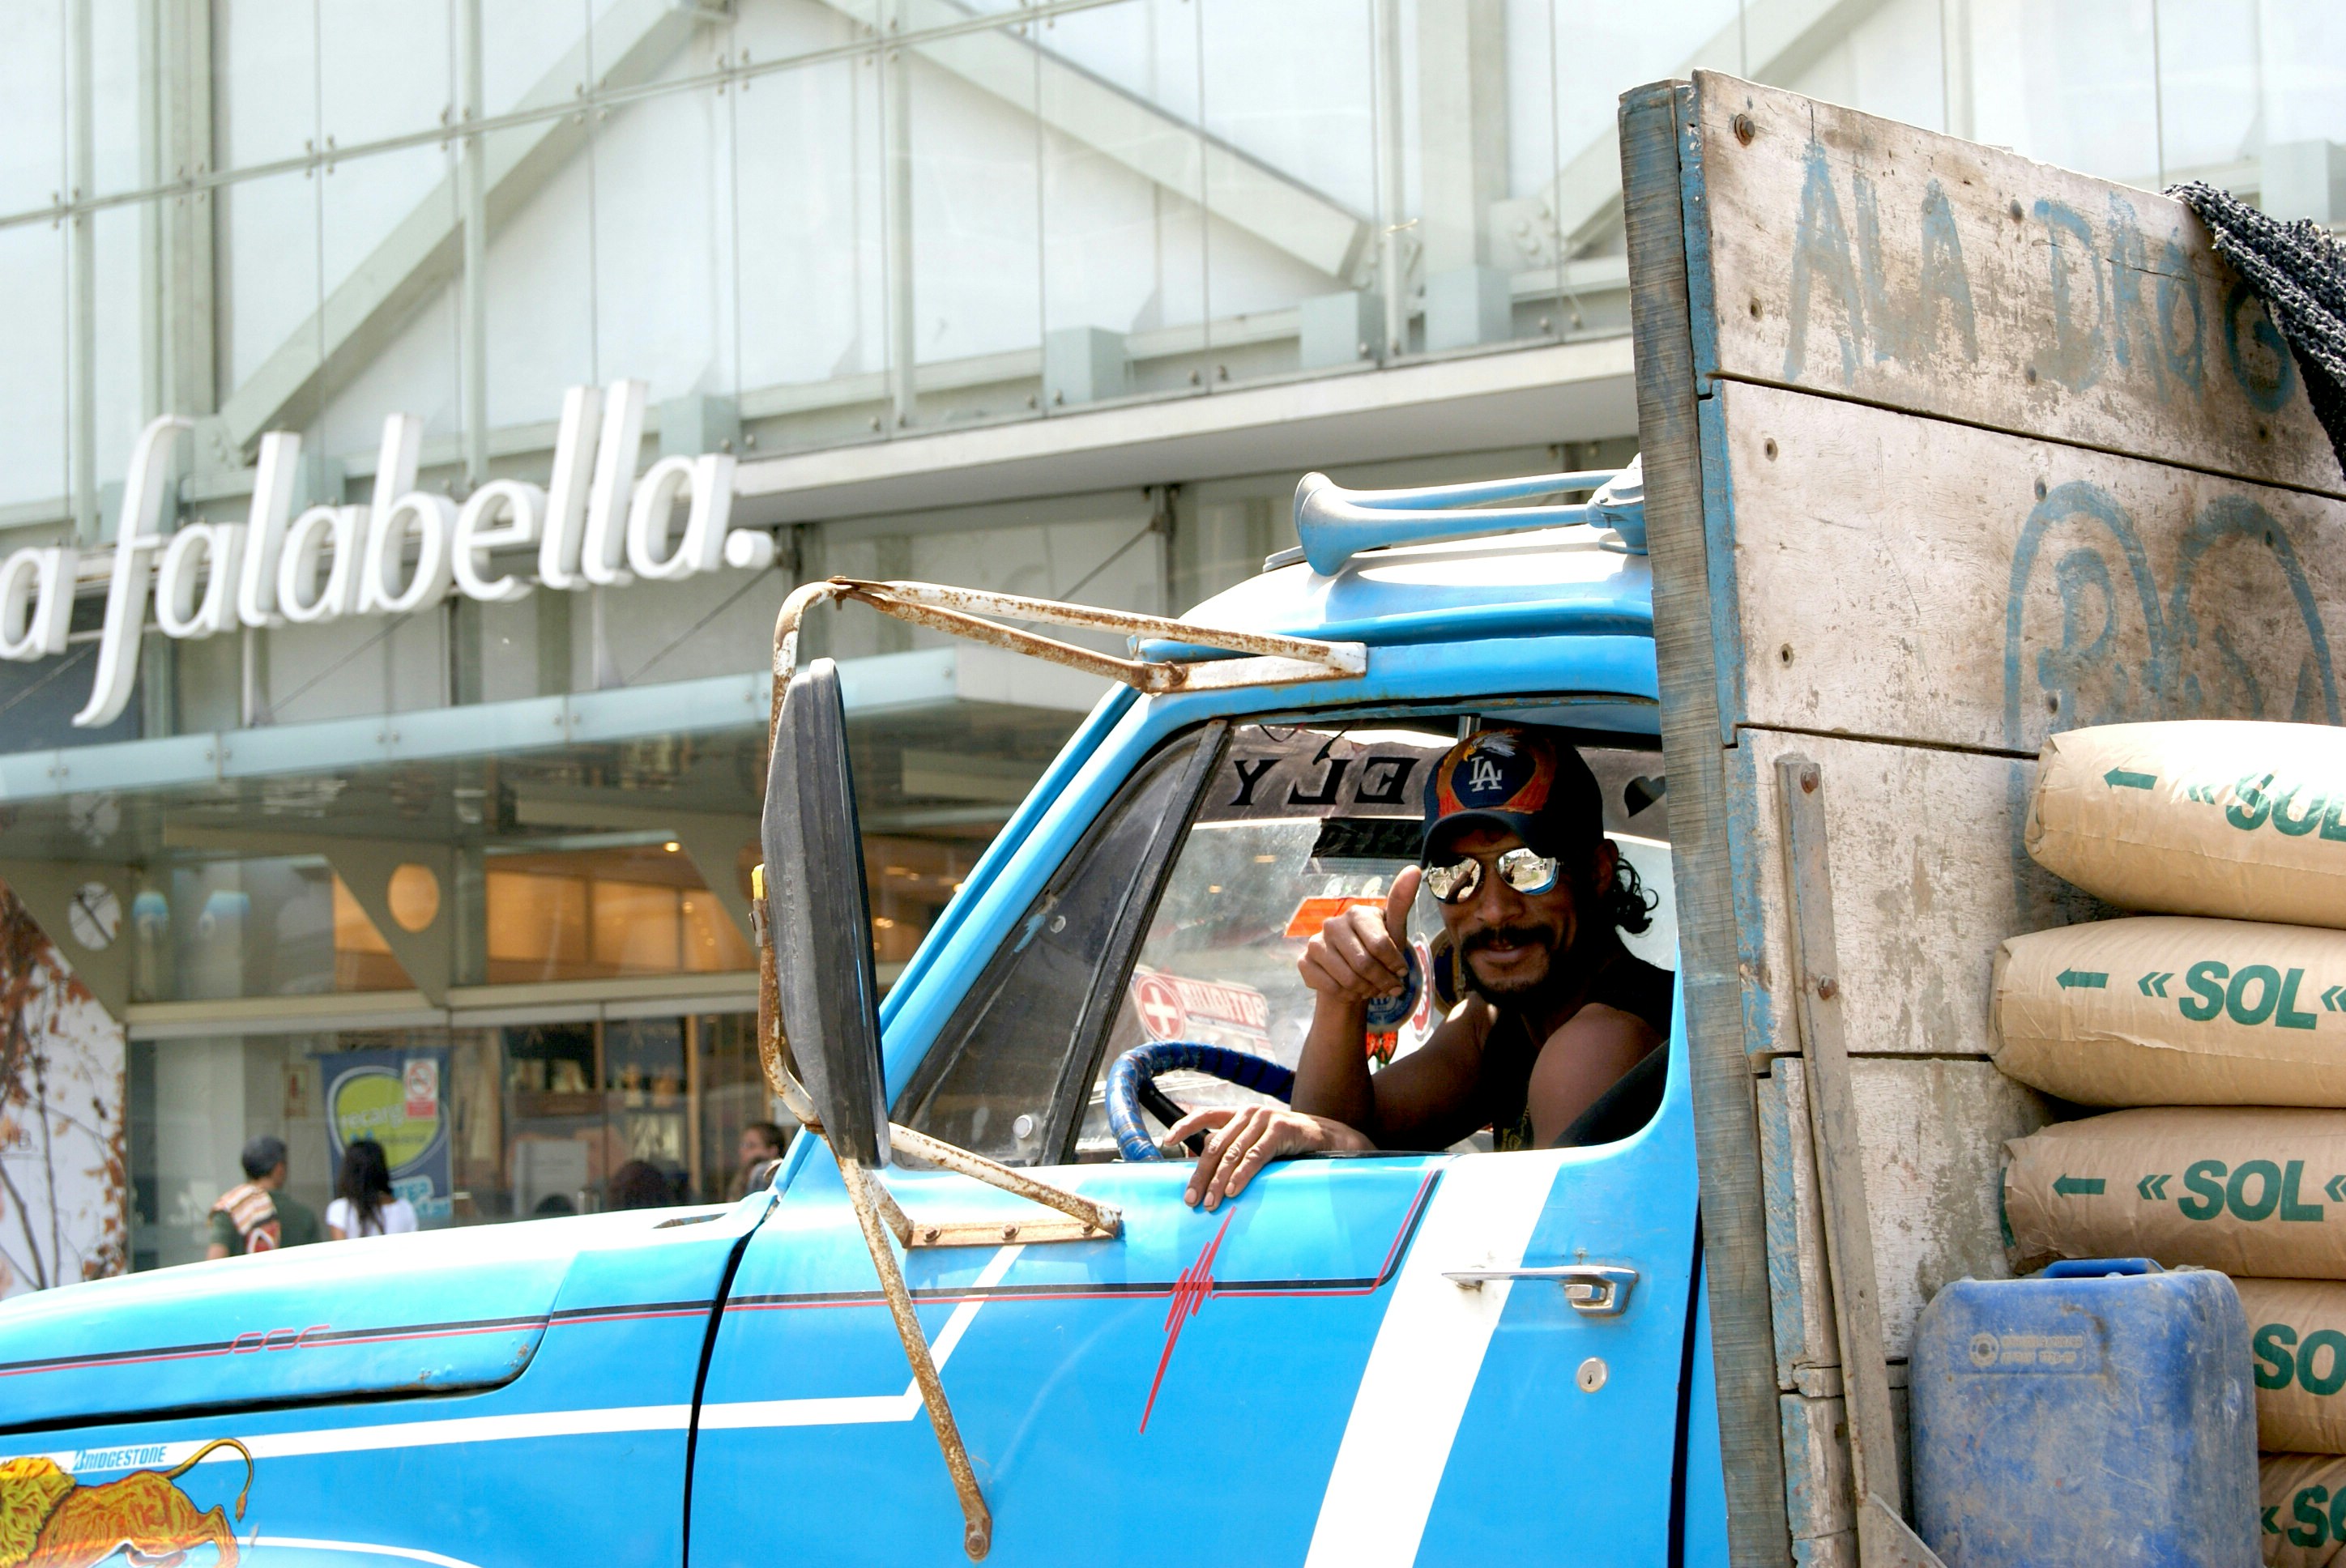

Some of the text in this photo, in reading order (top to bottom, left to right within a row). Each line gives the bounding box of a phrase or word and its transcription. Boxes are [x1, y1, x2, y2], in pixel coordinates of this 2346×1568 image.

[1469, 756, 1503, 792] LA
[2178, 961, 2318, 1030] SOL
[2178, 1160, 2324, 1222] SOL
[73, 1447, 167, 1471] BRIDGESTONE
